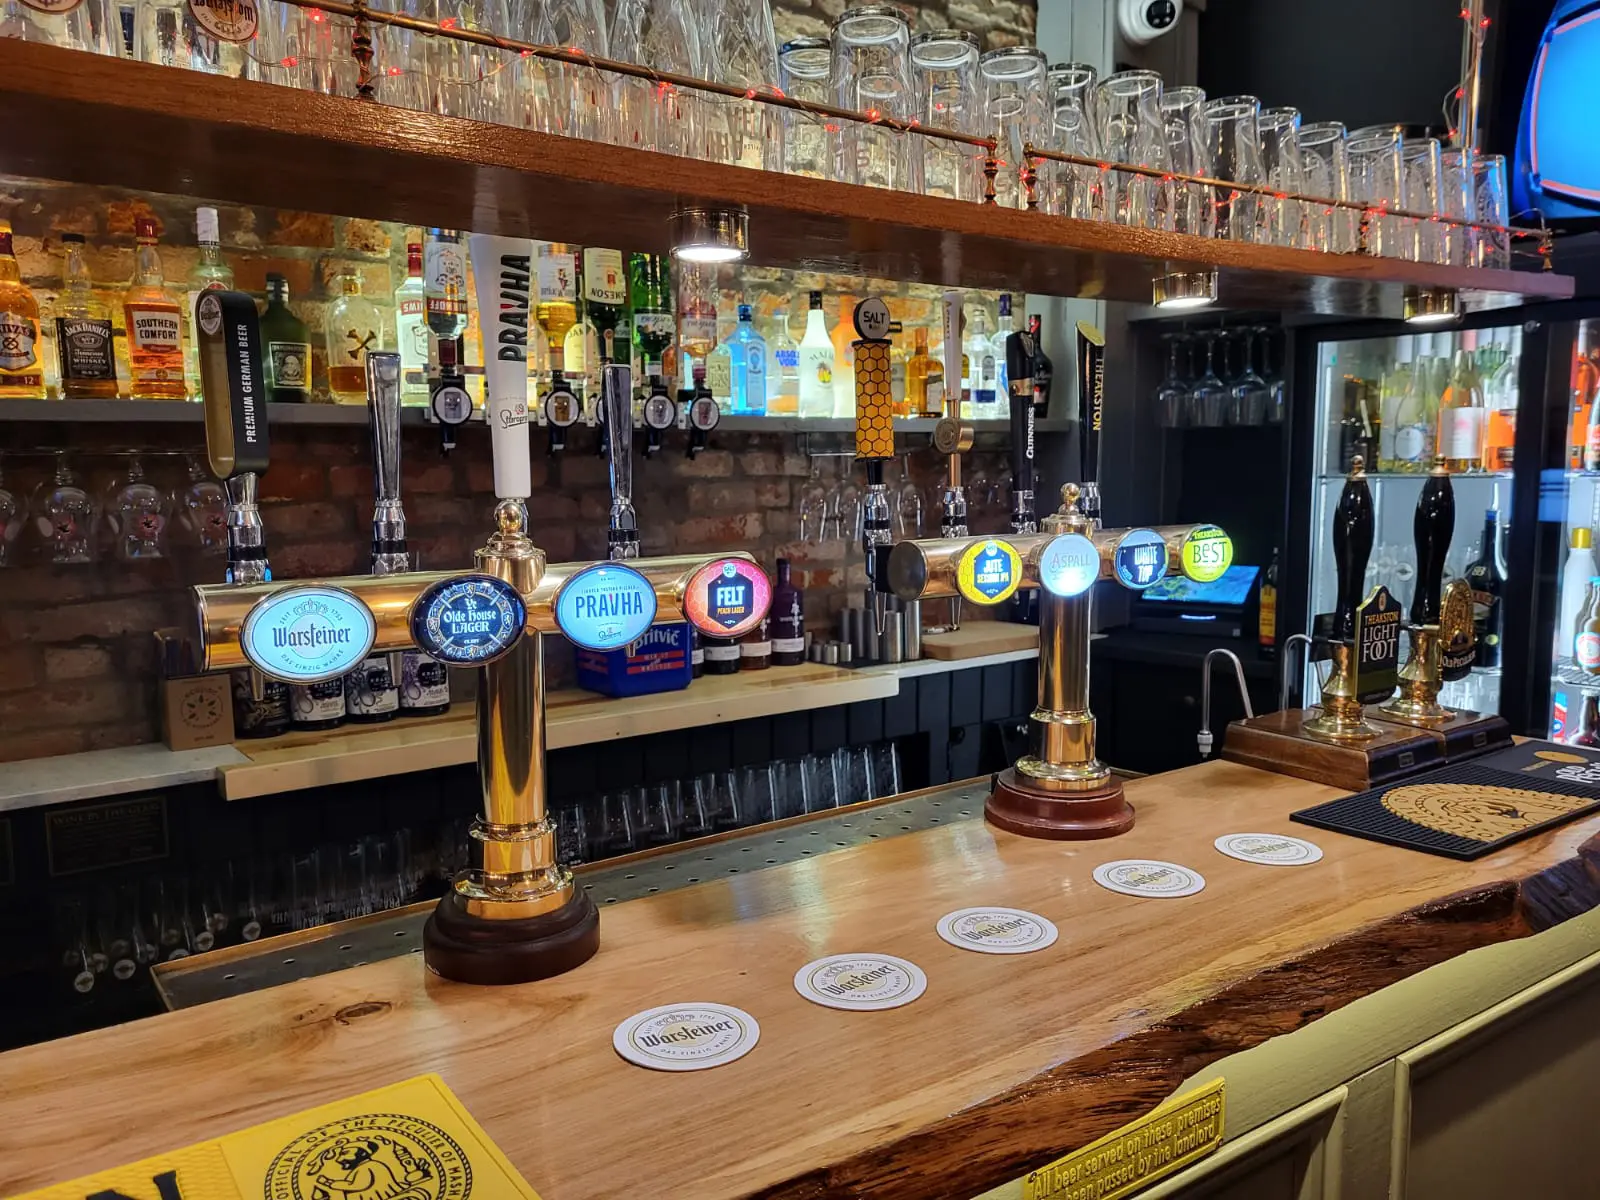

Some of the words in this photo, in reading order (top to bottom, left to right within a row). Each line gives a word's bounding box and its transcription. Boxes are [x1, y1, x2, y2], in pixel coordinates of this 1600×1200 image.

[194, 0, 254, 21] Wasteiner
[498, 254, 530, 361] PRAVHA
[863, 311, 886, 324] SALT
[136, 318, 178, 330] SOUTHERN
[139, 329, 177, 340] COMFORT
[237, 324, 249, 347] BEER
[24, 376, 34, 385] 12
[239, 350, 253, 393] GERMAN
[1092, 358, 1104, 431] THEAKSTON
[243, 396, 257, 443] PREMIUM
[1026, 406, 1035, 459] GUINNESS
[575, 591, 643, 618] PRAVHA
[716, 585, 745, 606] FELT
[443, 611, 466, 623] Olde
[468, 609, 497, 622] House
[452, 621, 490, 634] LAGER
[272, 622, 351, 648] Warsteiner
[1363, 623, 1398, 643] LIGHT
[1363, 639, 1397, 663] FOOT
[821, 965, 896, 996] Warsteiner
[639, 1020, 734, 1048] Warsteiner
[276, 1150, 301, 1200] OFFICIAL
[306, 1130, 328, 1143] OF
[341, 1118, 378, 1130] THE
[387, 1118, 445, 1154] PECULIER
[440, 1151, 456, 1164] OF
[448, 1165, 463, 1196] MASH
[1033, 1169, 1051, 1200] All
[1055, 1162, 1081, 1192] beer
[1085, 1141, 1124, 1177] served
[1127, 1136, 1141, 1156] on
[1144, 1122, 1173, 1148] these
[1177, 1097, 1222, 1133] premises
[1098, 1157, 1135, 1196] passed
[1138, 1152, 1151, 1177] by
[1174, 1116, 1215, 1157] landlord
